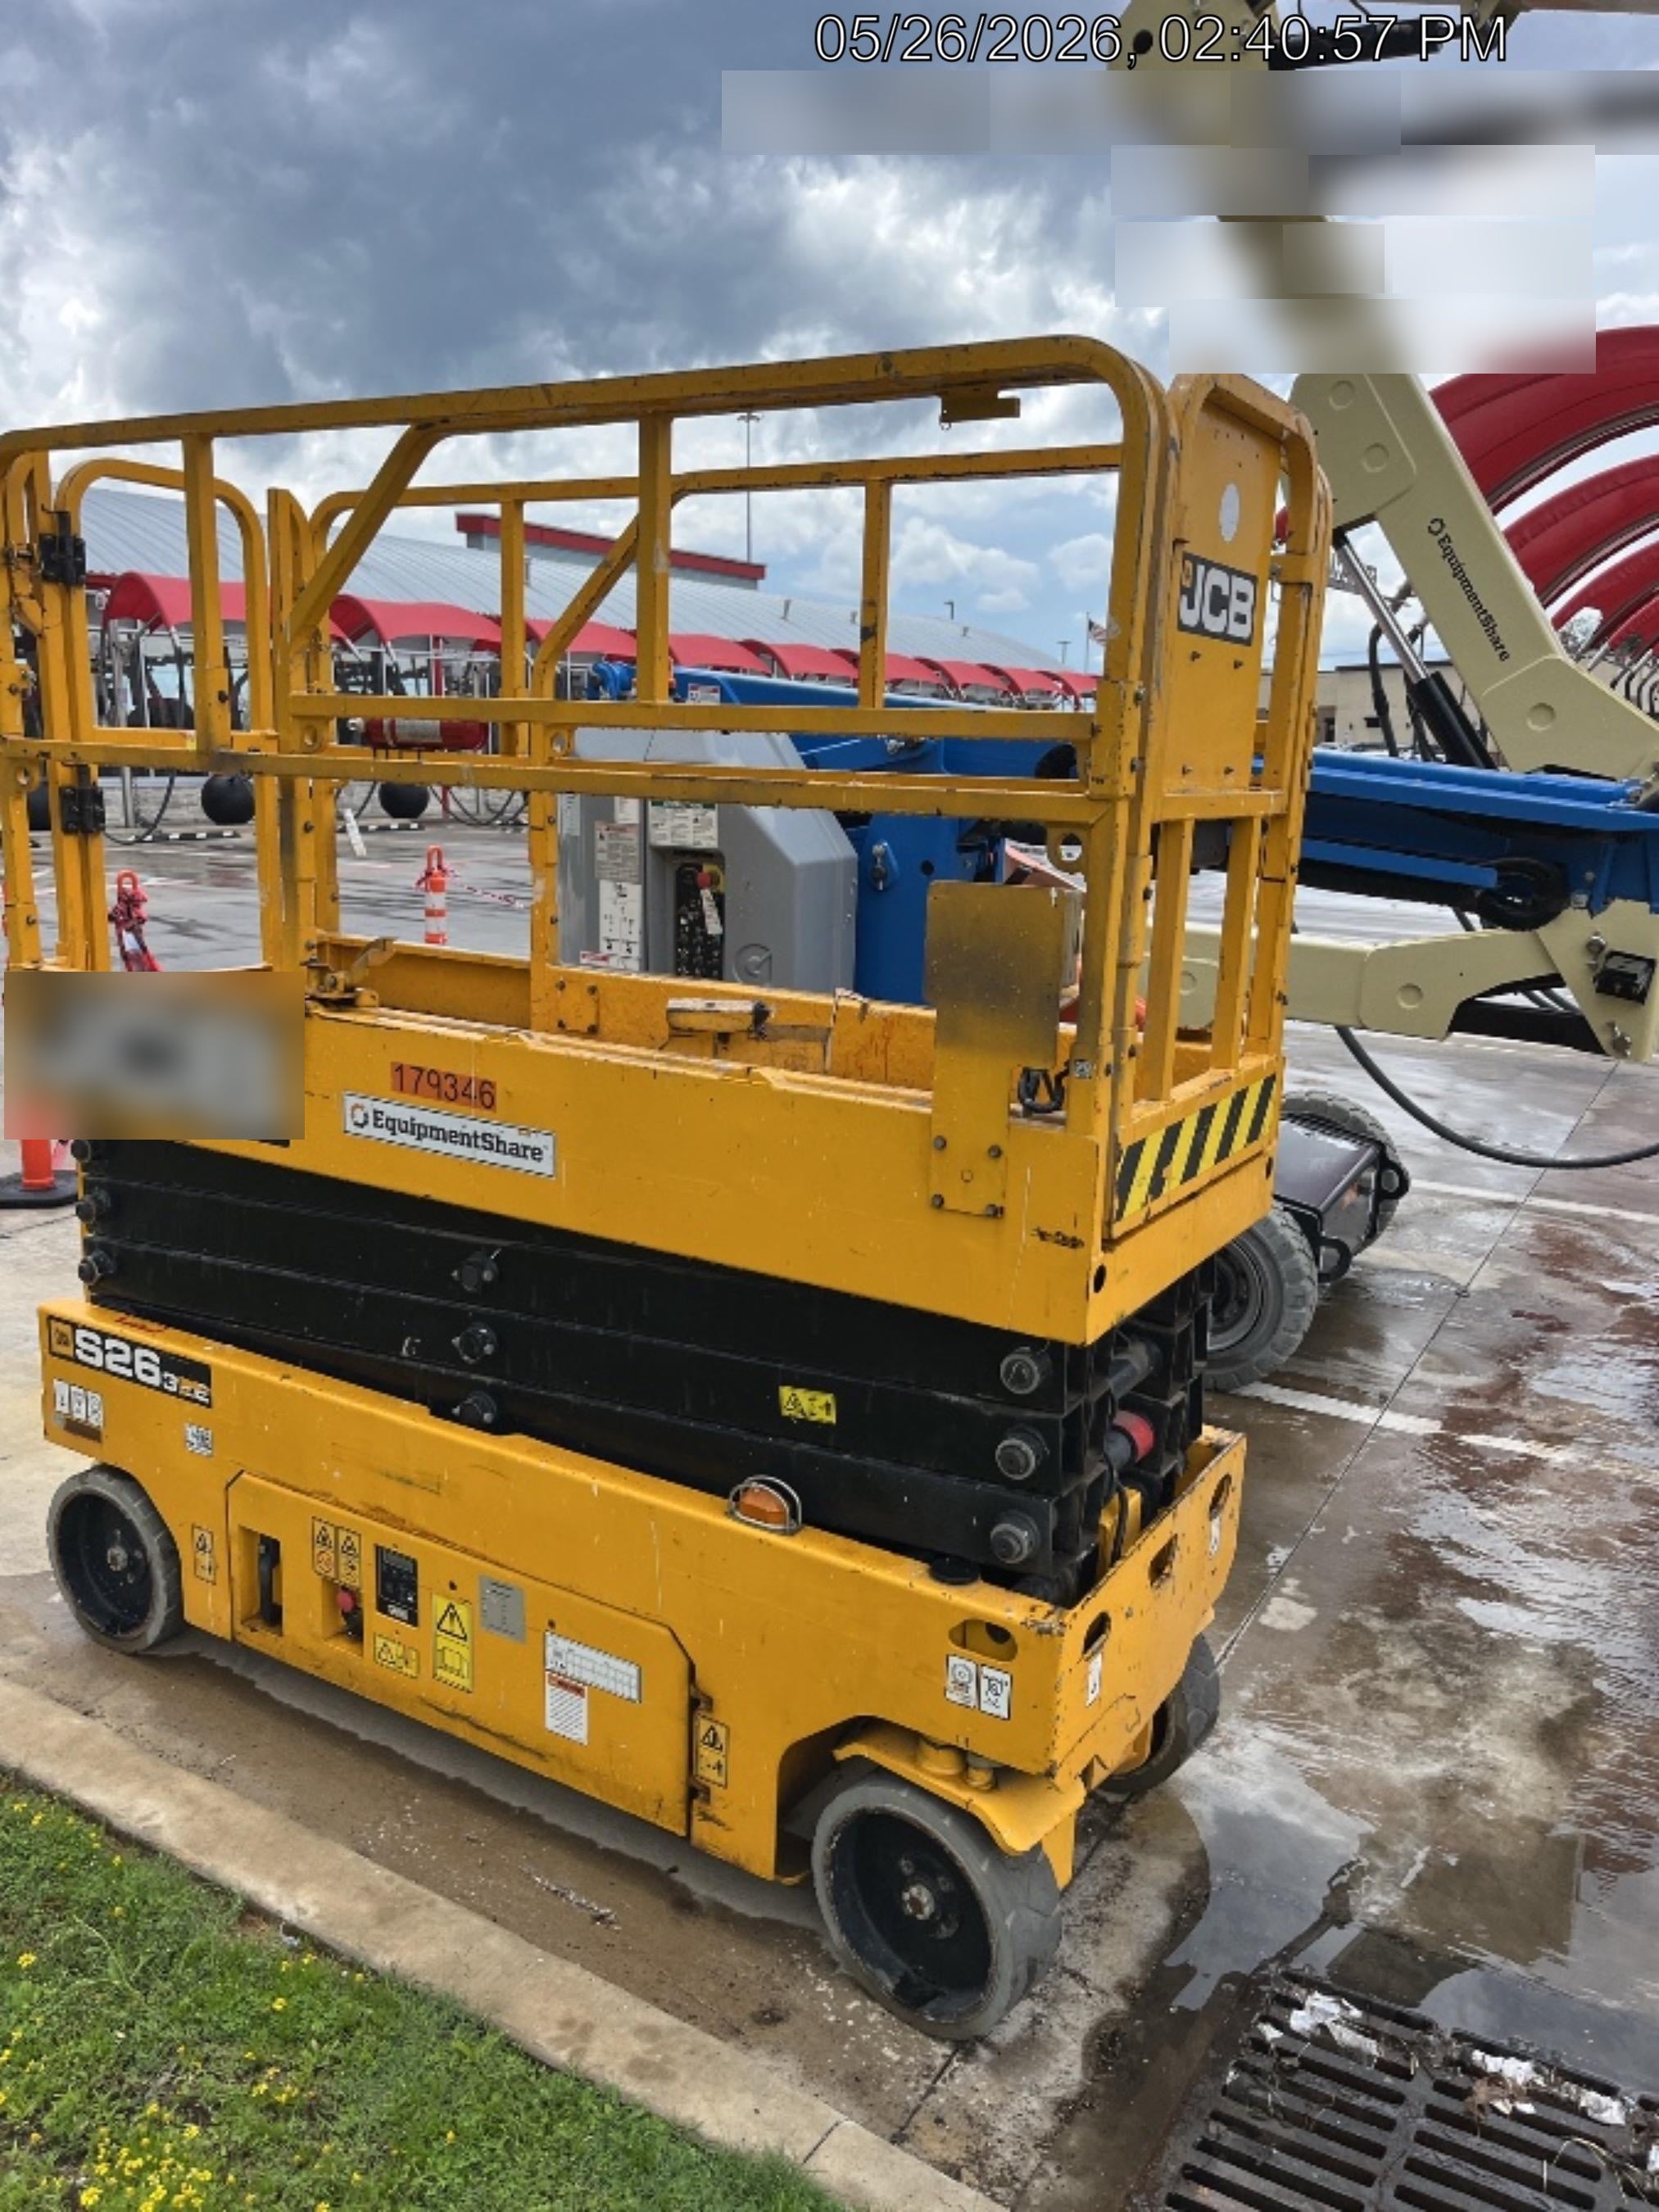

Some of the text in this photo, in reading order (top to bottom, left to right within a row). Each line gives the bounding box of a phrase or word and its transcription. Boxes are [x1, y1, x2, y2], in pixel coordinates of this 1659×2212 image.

[1180, 564, 1254, 638] JCB
[1438, 533, 1510, 662] EquipmentShare
[393, 1063, 495, 1109] 179346
[372, 1108, 543, 1163] EquipmentShare
